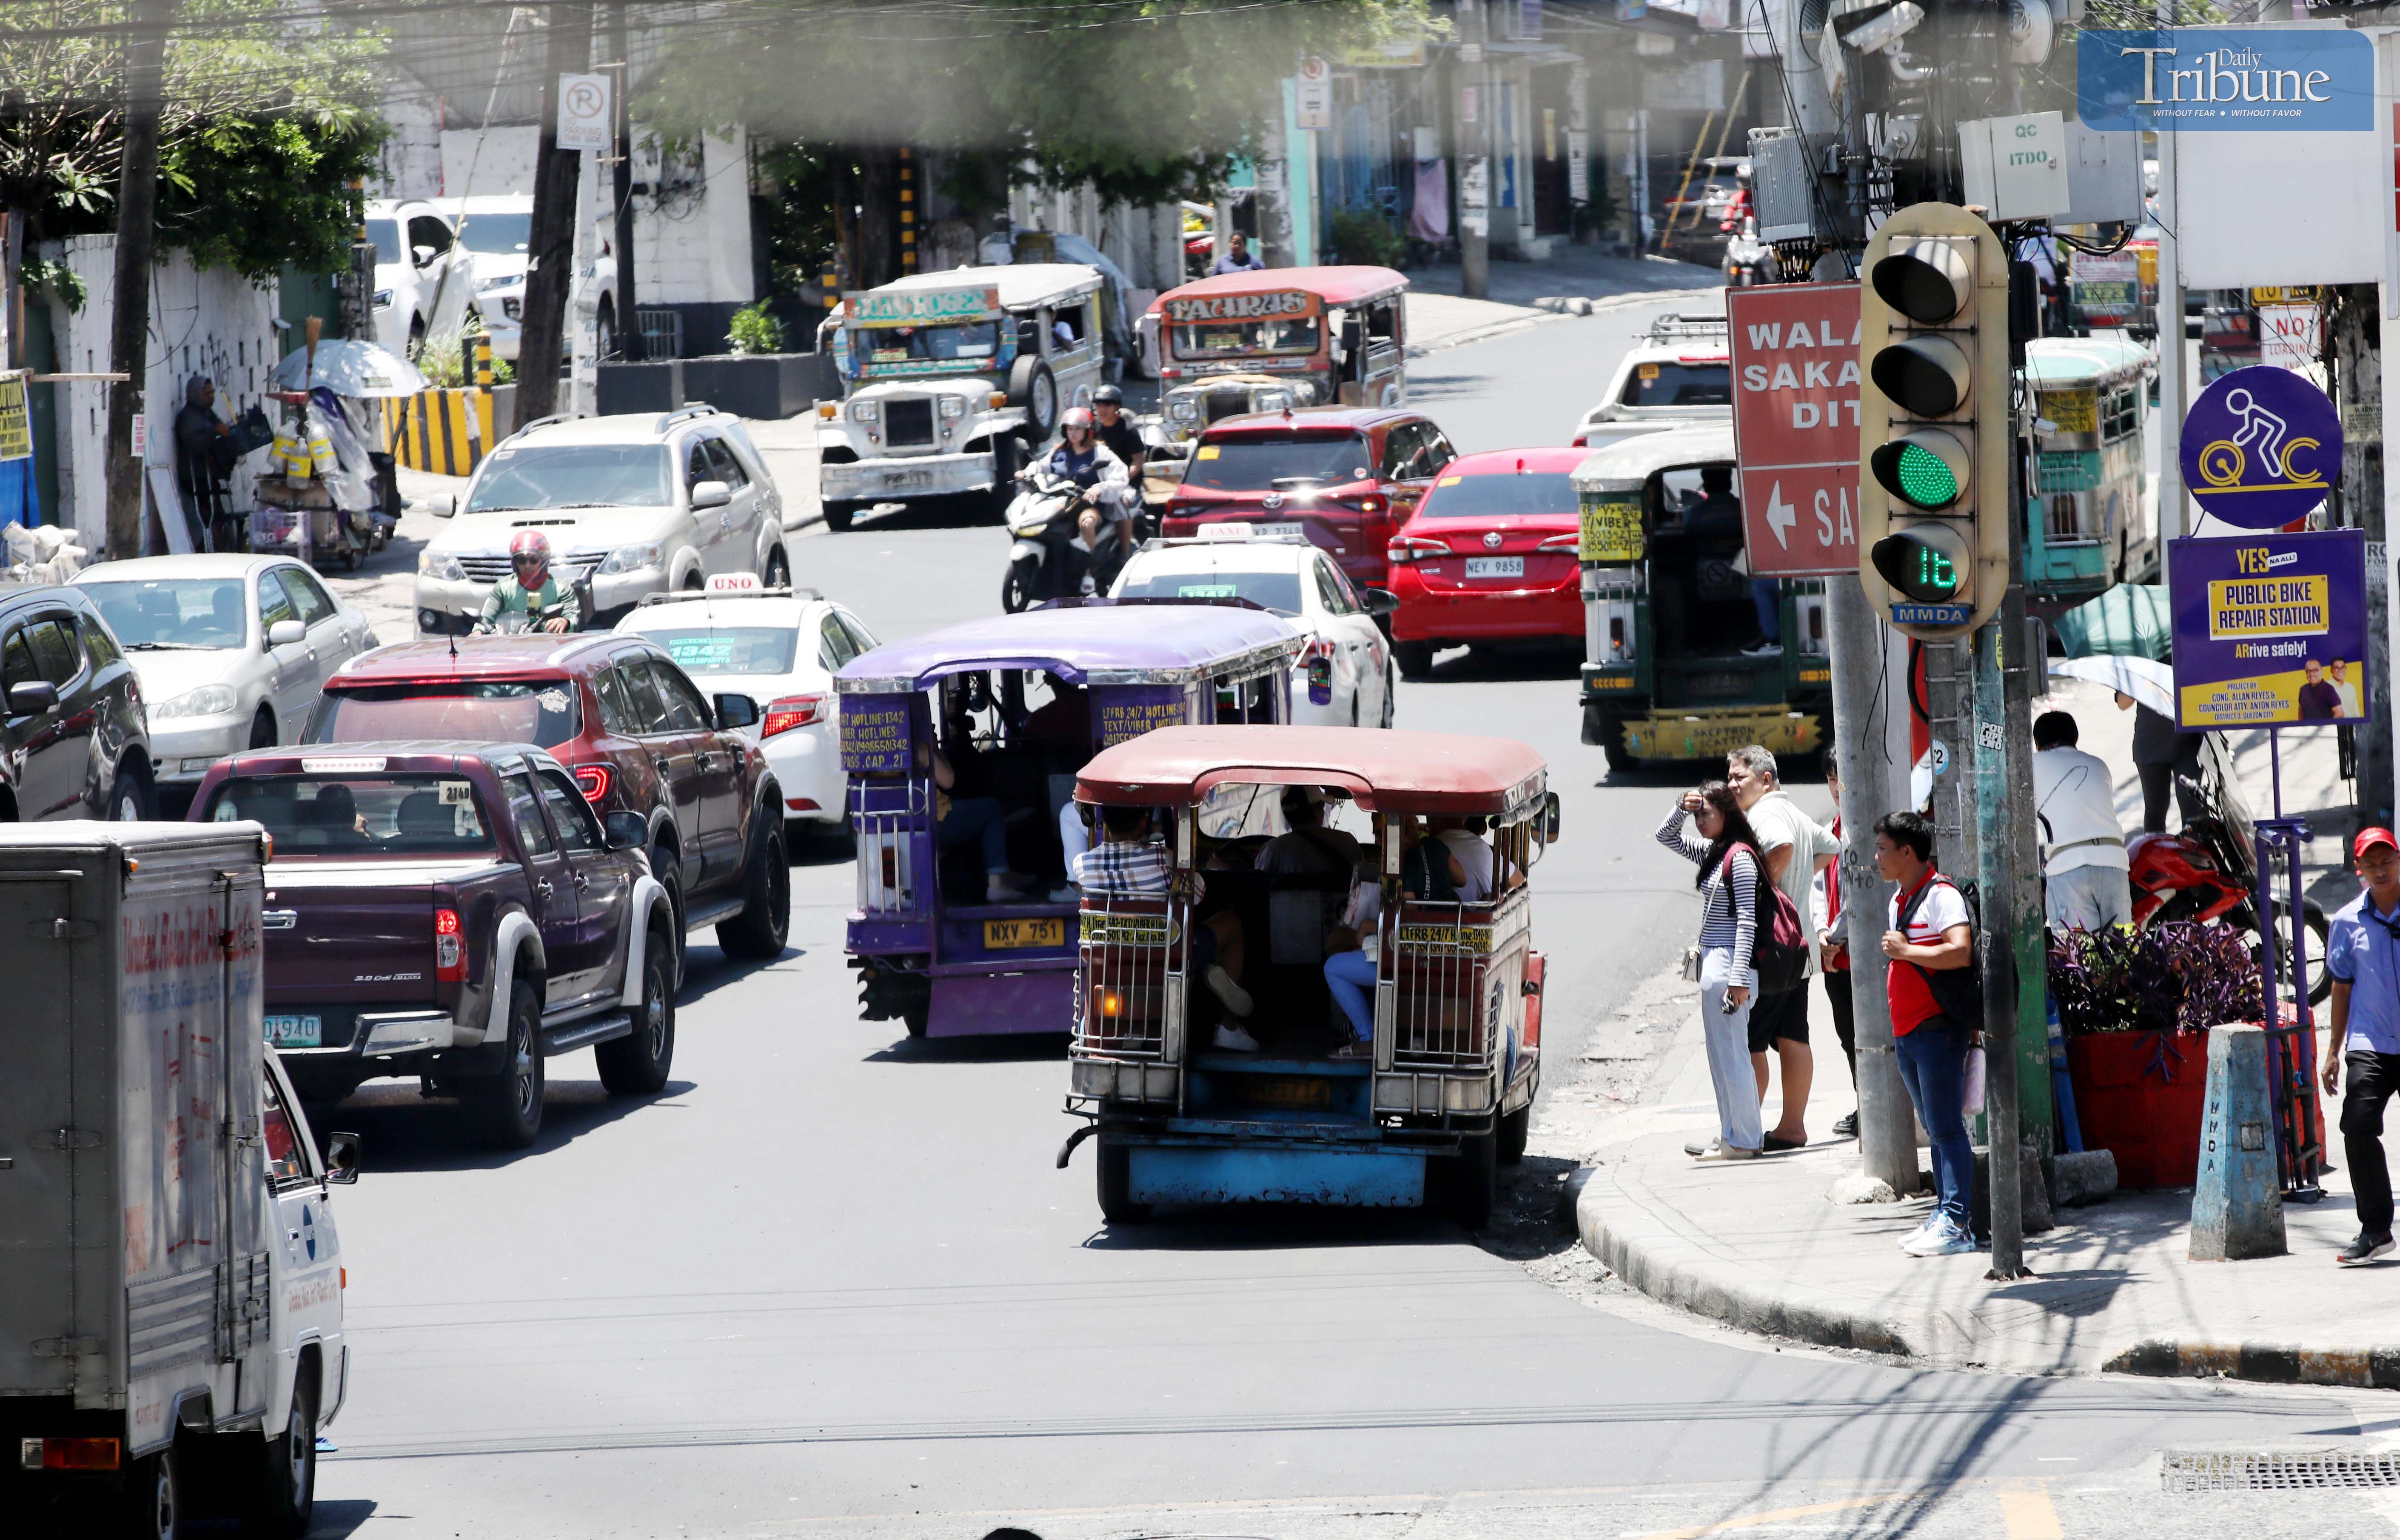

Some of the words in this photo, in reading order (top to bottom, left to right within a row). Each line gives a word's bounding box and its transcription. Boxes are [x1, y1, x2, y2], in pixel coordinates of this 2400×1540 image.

[2015, 124, 2037, 137] QC
[2010, 150, 2047, 165] ITDO
[1166, 291, 1307, 321] TAURUS
[2277, 317, 2304, 336] NO
[1815, 487, 1859, 548] SA
[1209, 527, 1246, 535] TAXI
[1468, 562, 1487, 573] NEY
[1496, 561, 1522, 572] 9858
[2236, 548, 2269, 573] YES
[714, 578, 752, 589] UNO
[2226, 584, 2275, 605] PUBLIC
[2280, 582, 2312, 602] BIKE
[1899, 608, 1964, 622] MMDA
[2219, 609, 2266, 629] REPAIR
[2270, 606, 2320, 626] STATION
[670, 646, 732, 658] 1342
[2235, 643, 2269, 658] ARrive
[2272, 641, 2306, 658] safely!
[2212, 693, 2230, 702] CONG.
[2232, 693, 2249, 701] ALLAN
[2252, 691, 2269, 700] REYES
[1103, 707, 1124, 719] LTFRB
[1126, 705, 1143, 719] 24/7
[2199, 703, 2232, 713] COUNCILOR
[2234, 702, 2248, 710] ATTY.
[2250, 702, 2269, 710] ANTON
[2271, 701, 2289, 709] REYES
[2215, 713, 2236, 721] DISTRICT
[2243, 712, 2262, 720] QUEZON
[1104, 718, 1152, 732] TEXT/VIBER
[1694, 726, 1755, 737] SKEPTRON
[991, 924, 1020, 941] NXV
[1029, 923, 1057, 940] 751
[1400, 928, 1428, 941] LTFRB
[1431, 927, 1449, 941] 24/7
[282, 1020, 313, 1037] 940
